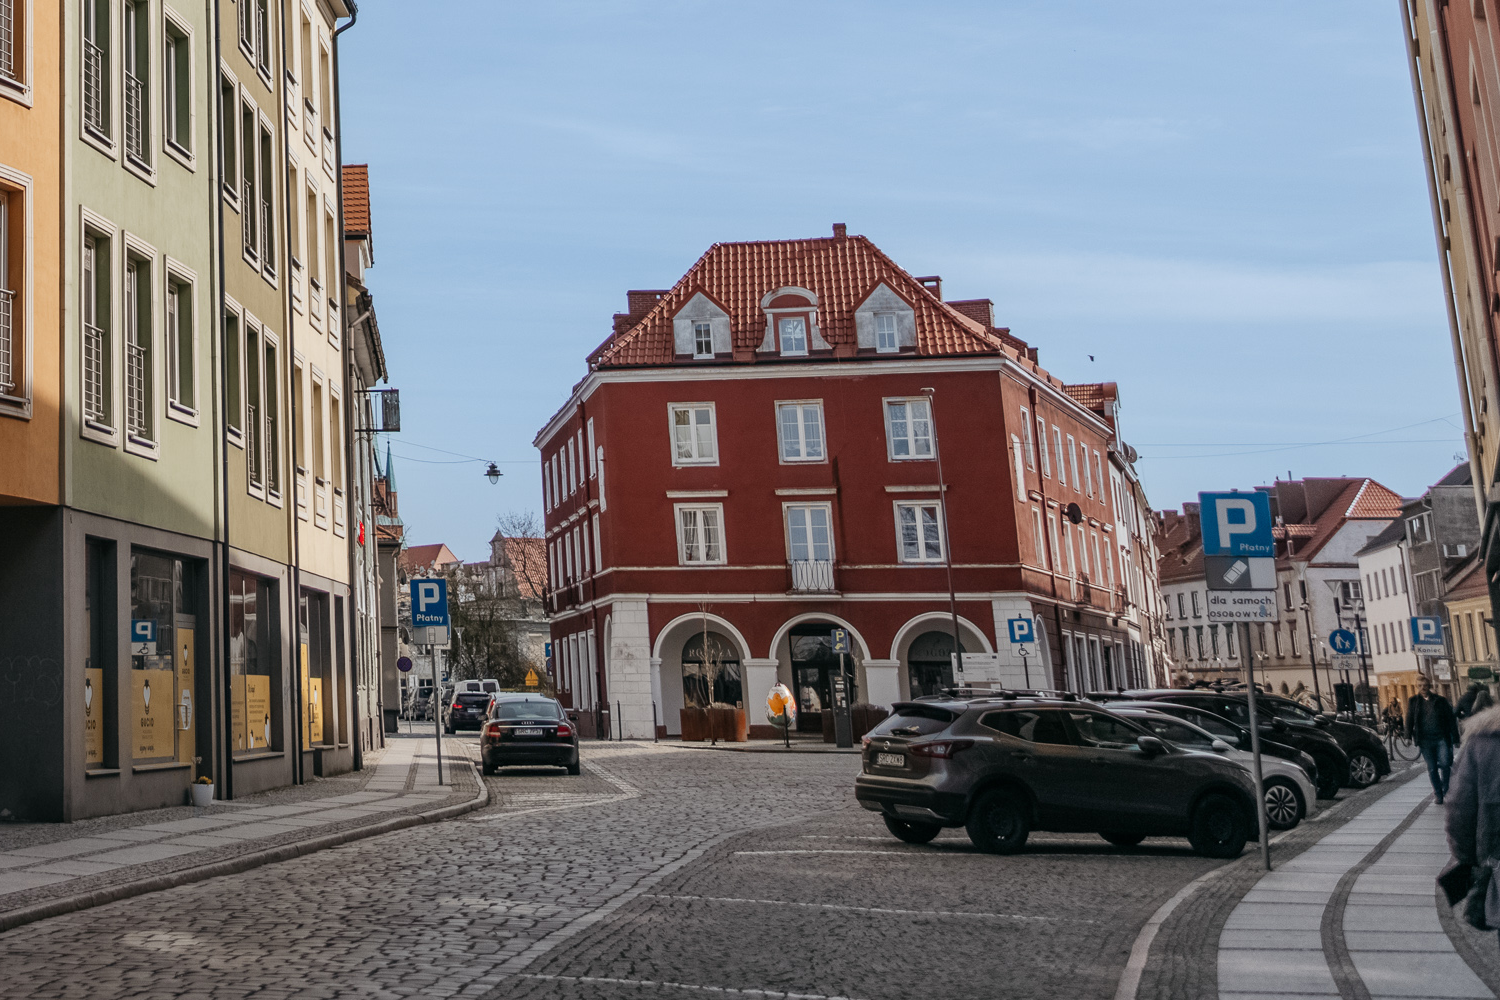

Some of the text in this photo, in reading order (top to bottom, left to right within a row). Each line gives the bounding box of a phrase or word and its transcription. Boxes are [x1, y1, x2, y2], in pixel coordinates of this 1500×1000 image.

[1216, 499, 1257, 548] P
[1240, 543, 1270, 552] Płatny
[418, 583, 440, 612] P
[1211, 595, 1275, 605] dla samoch.
[416, 614, 444, 624] Płatny
[1013, 620, 1029, 640] P
[1417, 619, 1435, 641] P
[835, 631, 845, 642] P
[1417, 646, 1441, 654] Koniec
